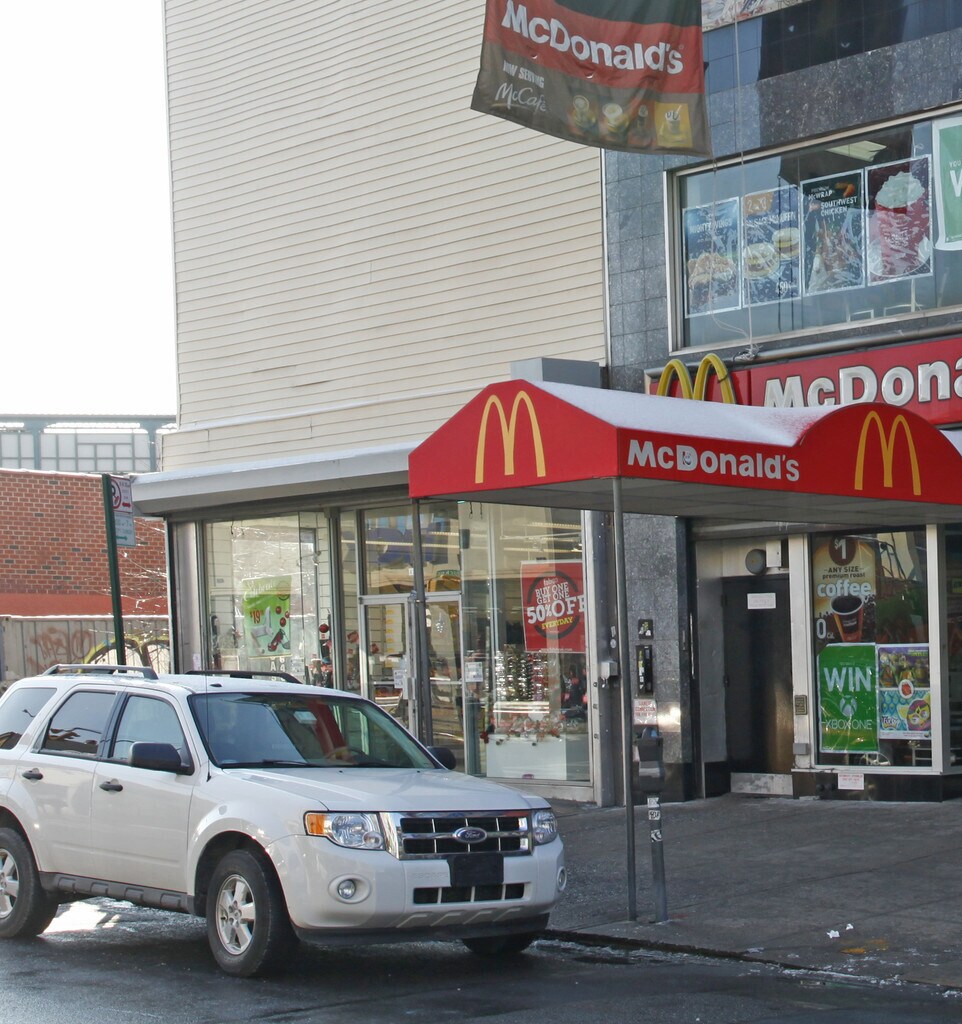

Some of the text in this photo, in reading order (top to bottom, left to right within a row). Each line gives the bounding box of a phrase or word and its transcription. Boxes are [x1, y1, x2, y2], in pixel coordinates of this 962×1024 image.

[820, 195, 858, 210] SOUTHWEST
[820, 206, 849, 217] CHICKEN
[628, 439, 800, 482] McDonald's
[828, 565, 860, 574] ANY SIZE
[535, 581, 569, 598] BUY ONE
[817, 579, 872, 597] coffee
[536, 590, 570, 605] GET ONE
[541, 616, 573, 630] EVERYDAY
[823, 665, 872, 692] WIN
[851, 719, 873, 730] ONE
